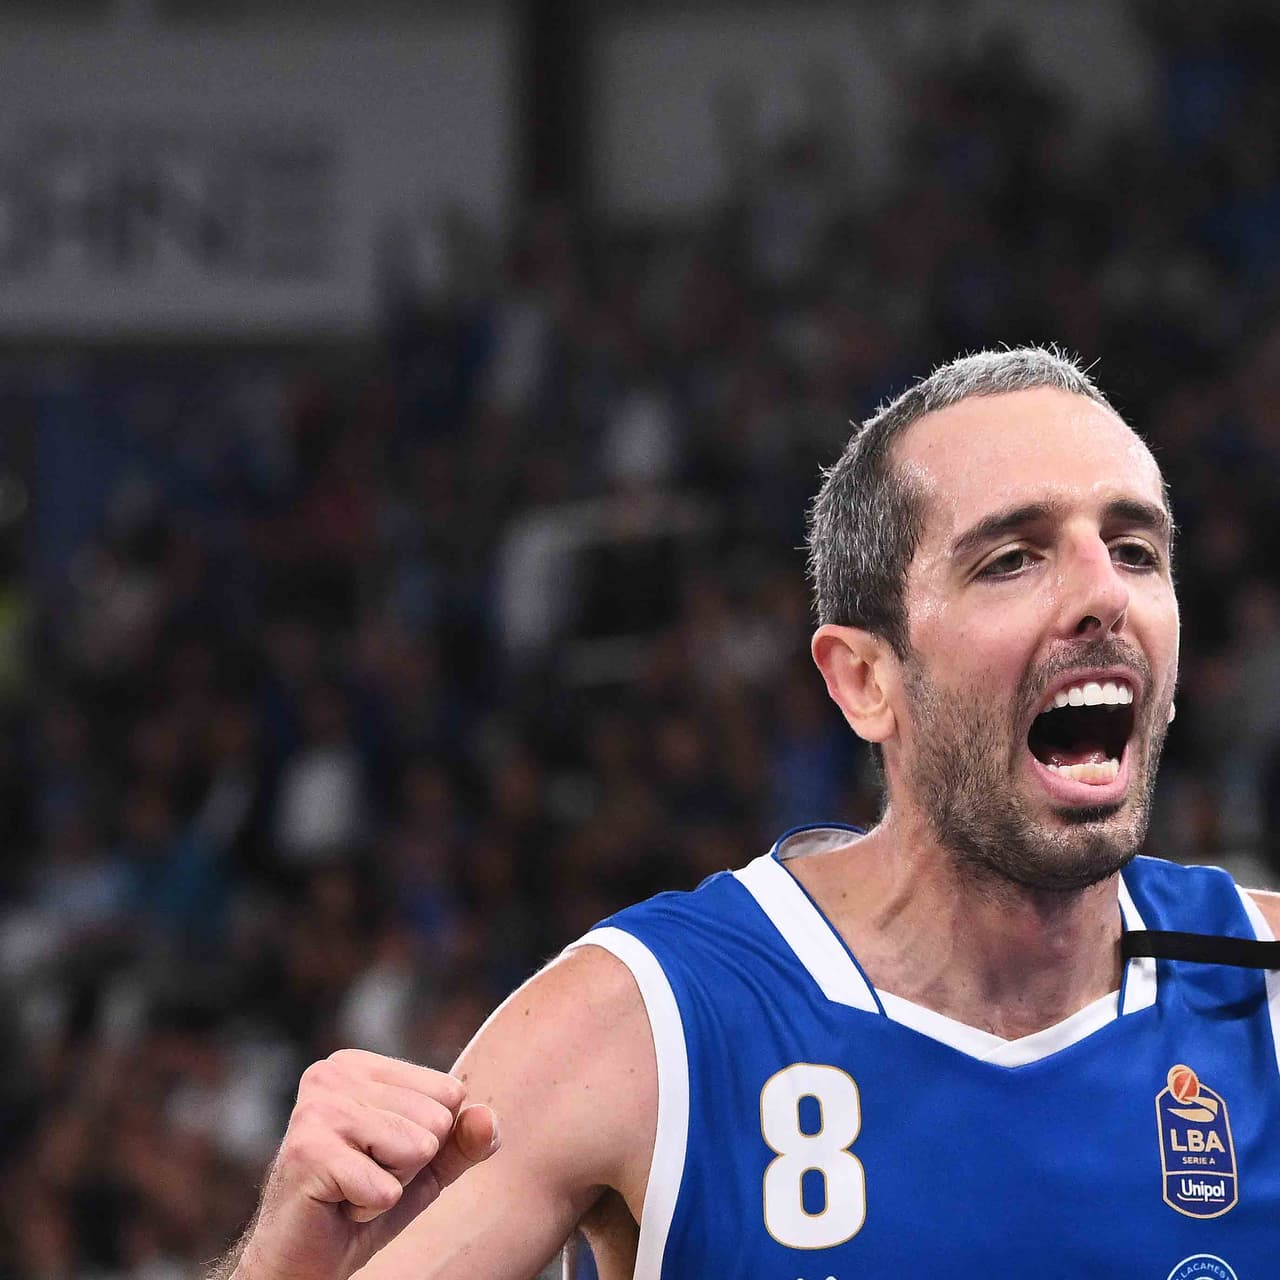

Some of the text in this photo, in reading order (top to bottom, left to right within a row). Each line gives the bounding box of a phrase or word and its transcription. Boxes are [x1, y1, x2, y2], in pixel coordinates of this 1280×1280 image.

[1170, 1129, 1225, 1152] LBA
[760, 1062, 866, 1250] 8
[1182, 1156, 1216, 1165] SERIE A
[1180, 1178, 1225, 1202] Unipol
